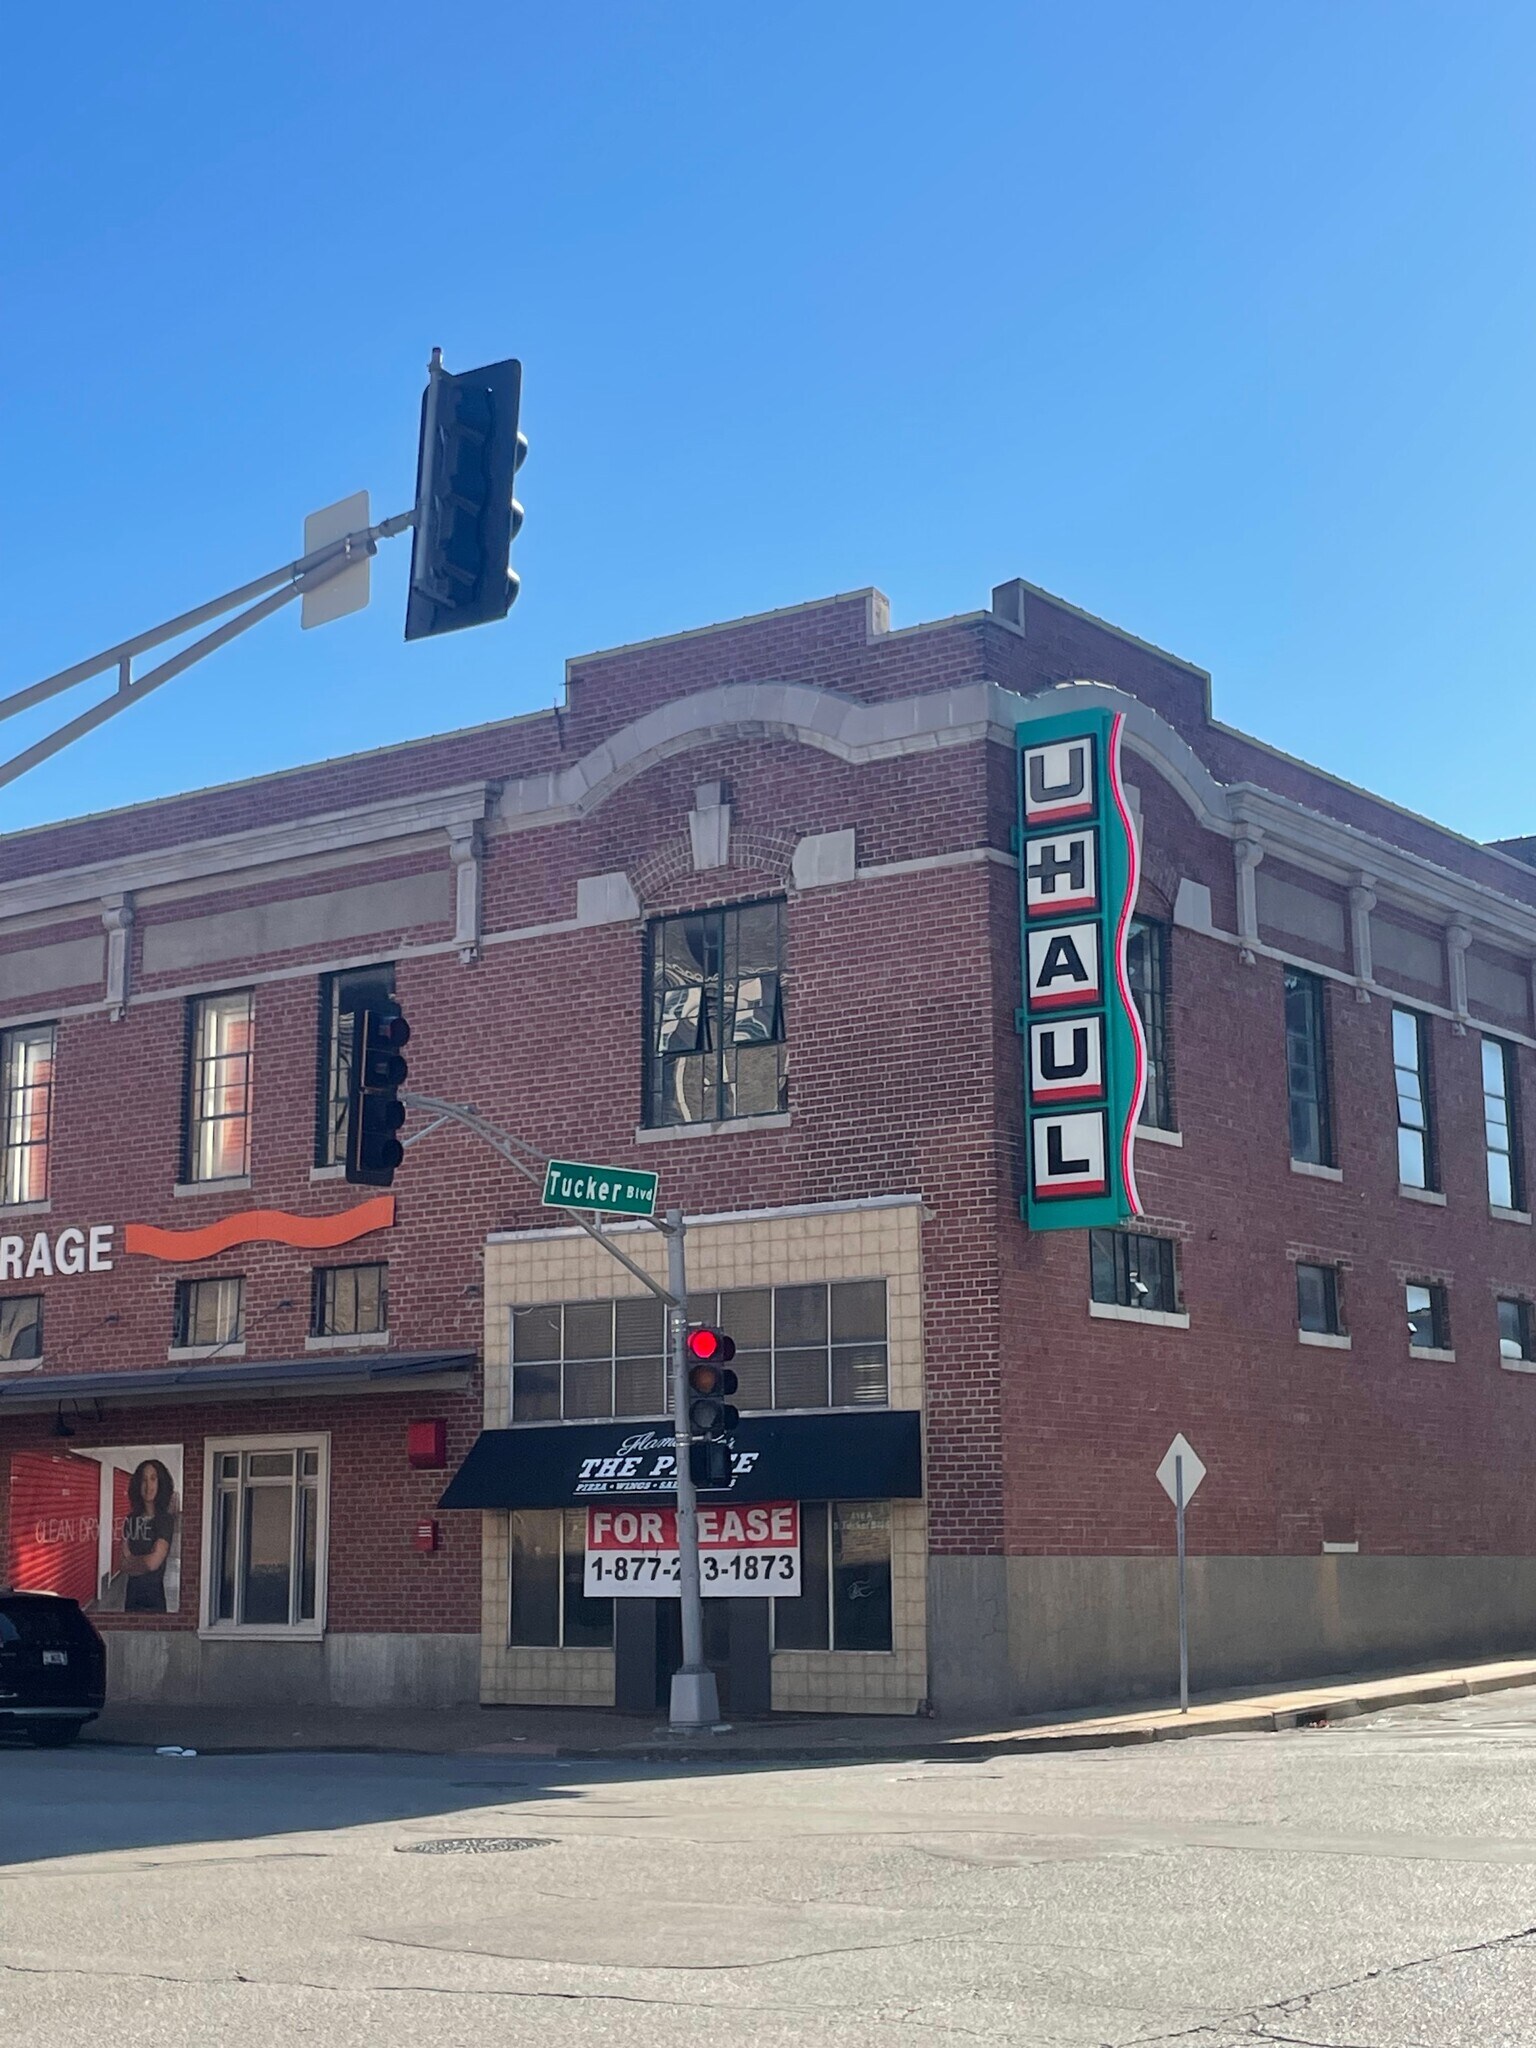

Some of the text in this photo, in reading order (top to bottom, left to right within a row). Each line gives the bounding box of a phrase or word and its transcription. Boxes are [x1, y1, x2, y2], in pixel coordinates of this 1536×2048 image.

[550, 1170, 653, 1202] Tucker Blvd
[0, 1225, 114, 1281] RAGE
[578, 1456, 643, 1478] THE
[616, 1481, 651, 1490] WINGS
[593, 1507, 793, 1543] FOR EASE
[591, 1554, 794, 1581] 1-877-23-1873
